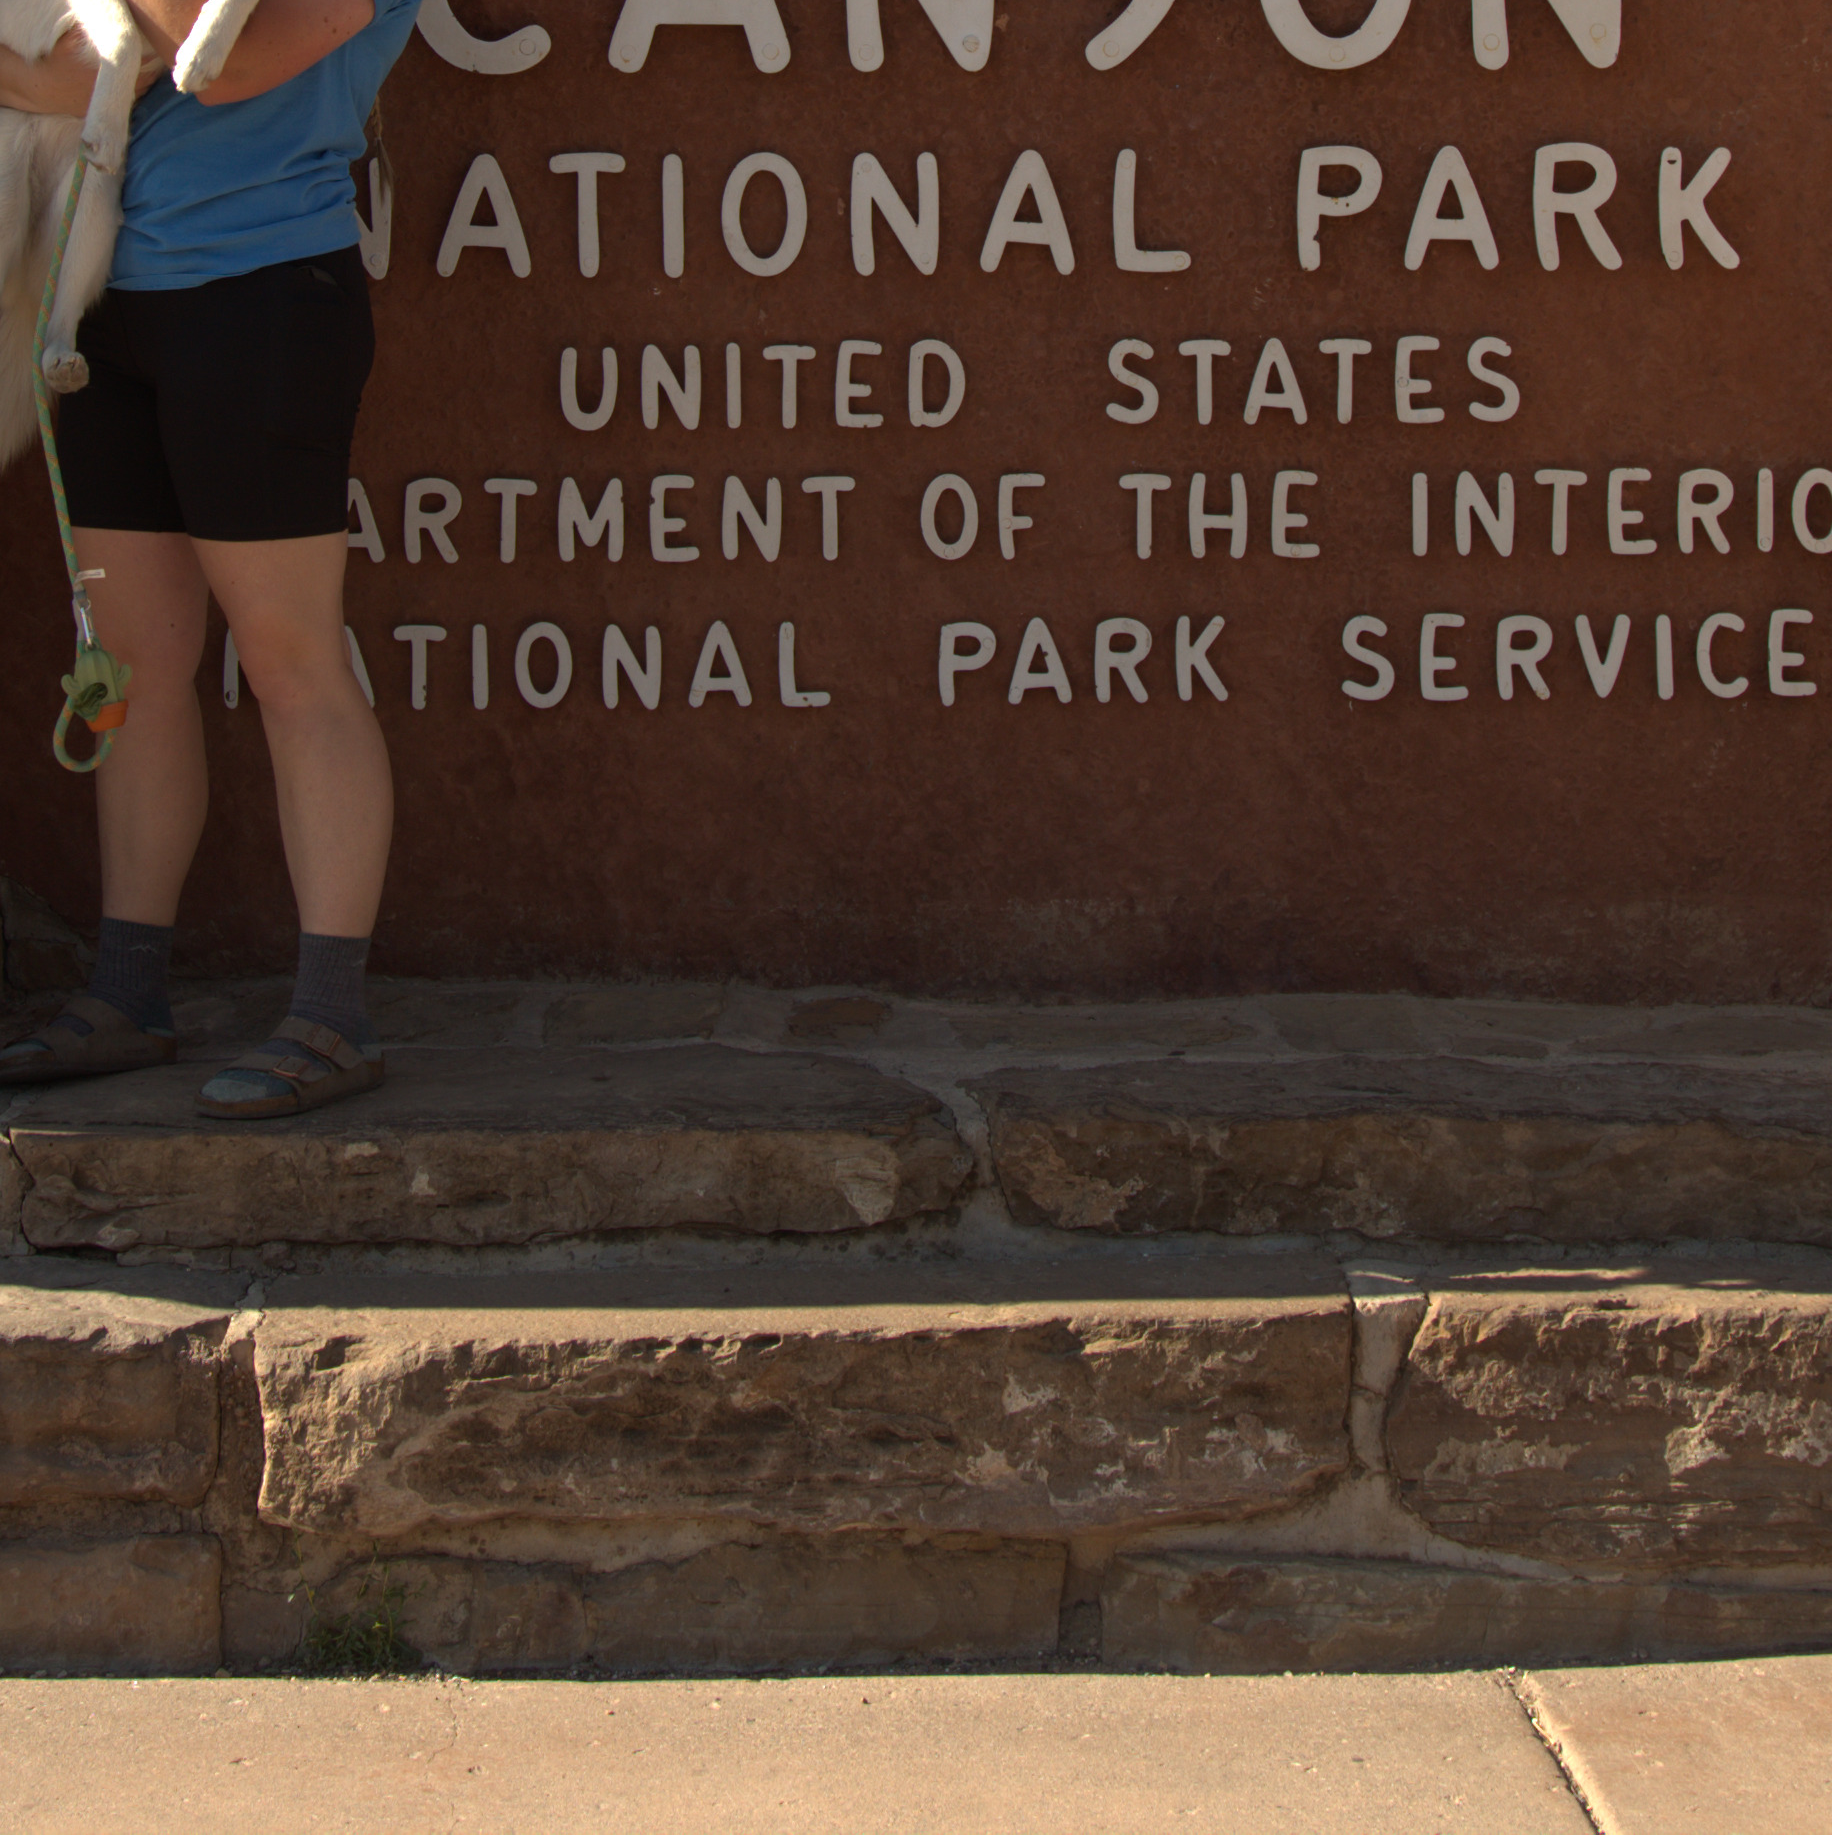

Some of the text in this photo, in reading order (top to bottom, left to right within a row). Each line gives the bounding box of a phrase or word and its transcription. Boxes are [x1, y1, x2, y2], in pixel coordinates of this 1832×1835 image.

[1297, 142, 1740, 271] PARK
[561, 336, 1520, 430] UNITED STATES
[348, 475, 855, 563] ARTMENT
[921, 473, 1045, 560] OF
[1119, 470, 1320, 559] THE
[224, 609, 1816, 710] TIONAL PARK SERVICE
